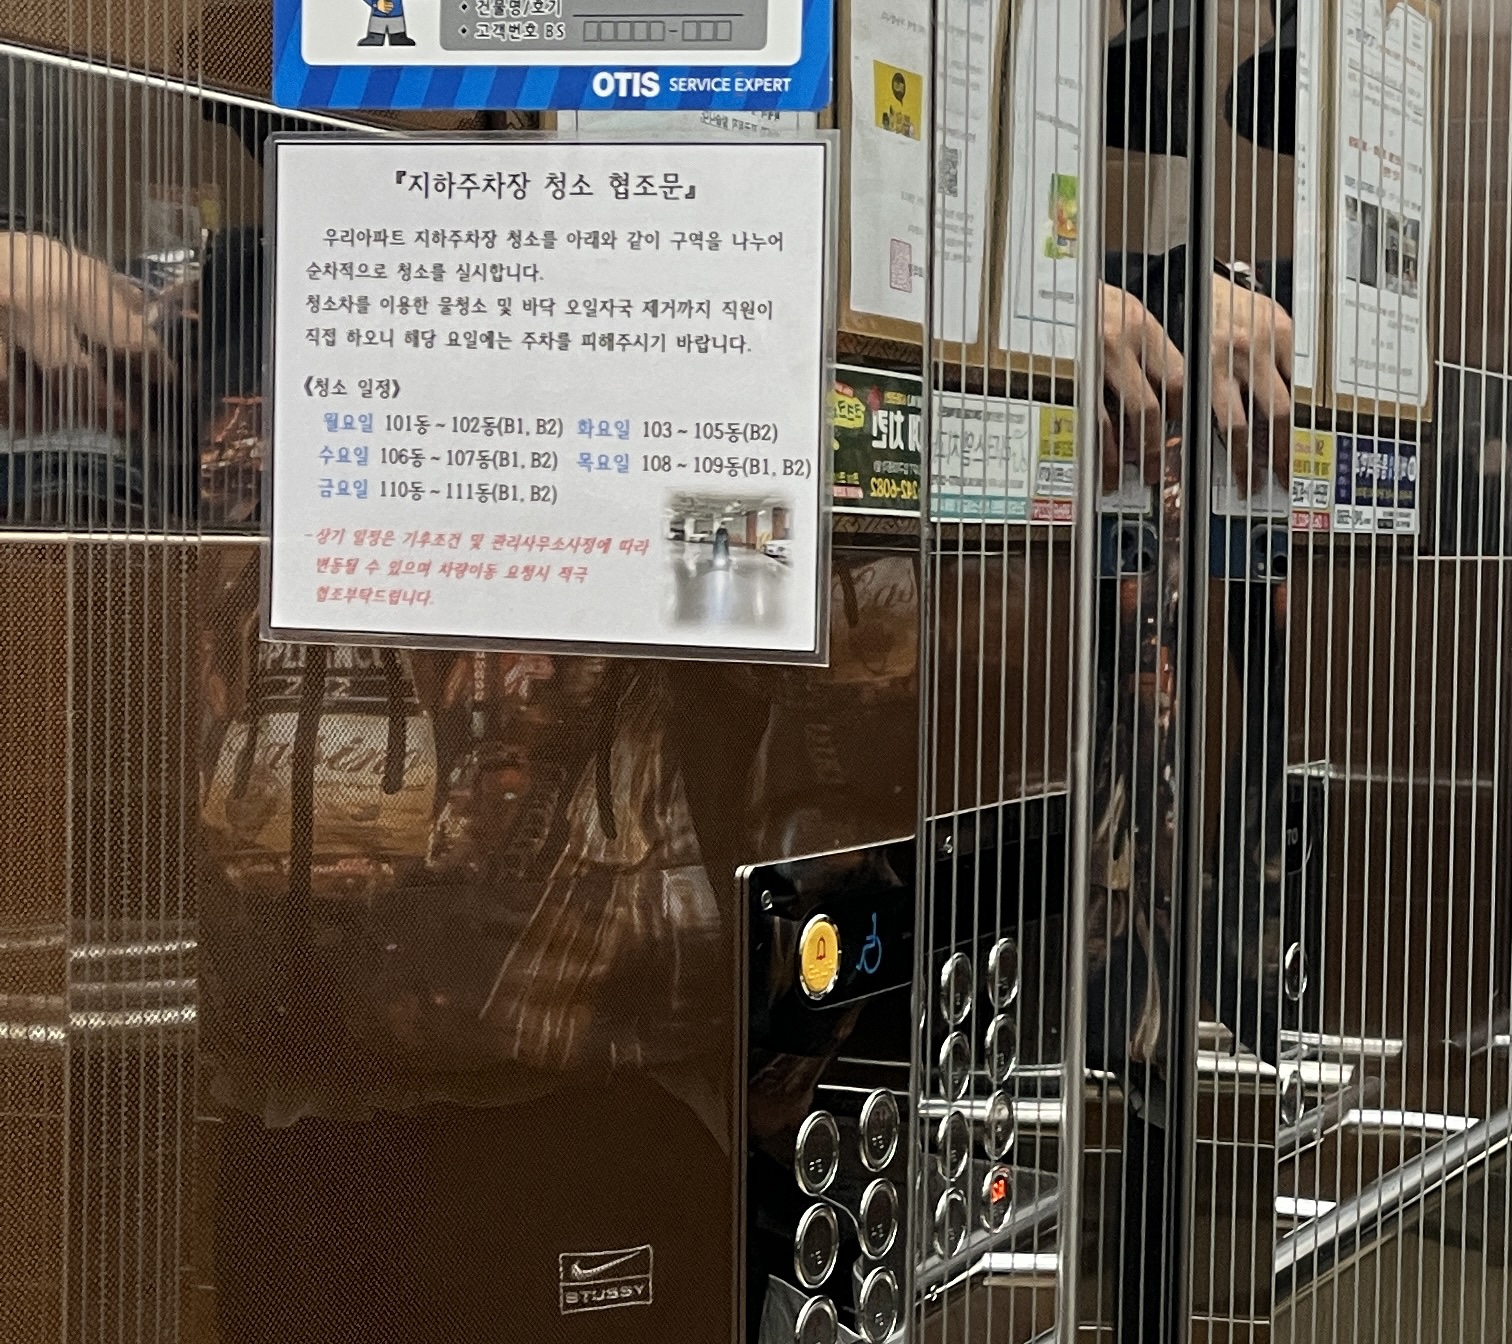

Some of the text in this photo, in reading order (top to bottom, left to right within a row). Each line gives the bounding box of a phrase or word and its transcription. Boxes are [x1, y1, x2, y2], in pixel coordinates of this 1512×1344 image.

[473, 21, 567, 42] 고객번호 BS
[592, 71, 792, 98] OTIS SERVICE EXPERT
[542, 170, 596, 202] 청소
[321, 226, 784, 253] 우리아파트 지하주차장 청소를 아래와 같이 구역을 나누어
[304, 260, 545, 284] 순차적으로 청소를 실시합니다.
[304, 293, 774, 322] 청소차를 이용한 물청소 및 바닥 오일자국 제거까지 직원이
[304, 325, 753, 356] 직접 하오니 해당 요일에는 주차를 피해주시기 바랍니다.
[322, 411, 374, 434] 월요일
[576, 417, 631, 441] 화요일
[317, 444, 370, 467] 수요일
[575, 451, 630, 475] 목요일
[317, 477, 369, 500] 금요일
[352, 527, 397, 548] 일정은
[401, 529, 464, 550] 기후조건
[468, 532, 486, 552] 및
[617, 537, 651, 557] 따라
[315, 555, 589, 585] 변동될 수 있으며 차량이동 요청시 적극
[564, 1283, 646, 1304] STUSSY
